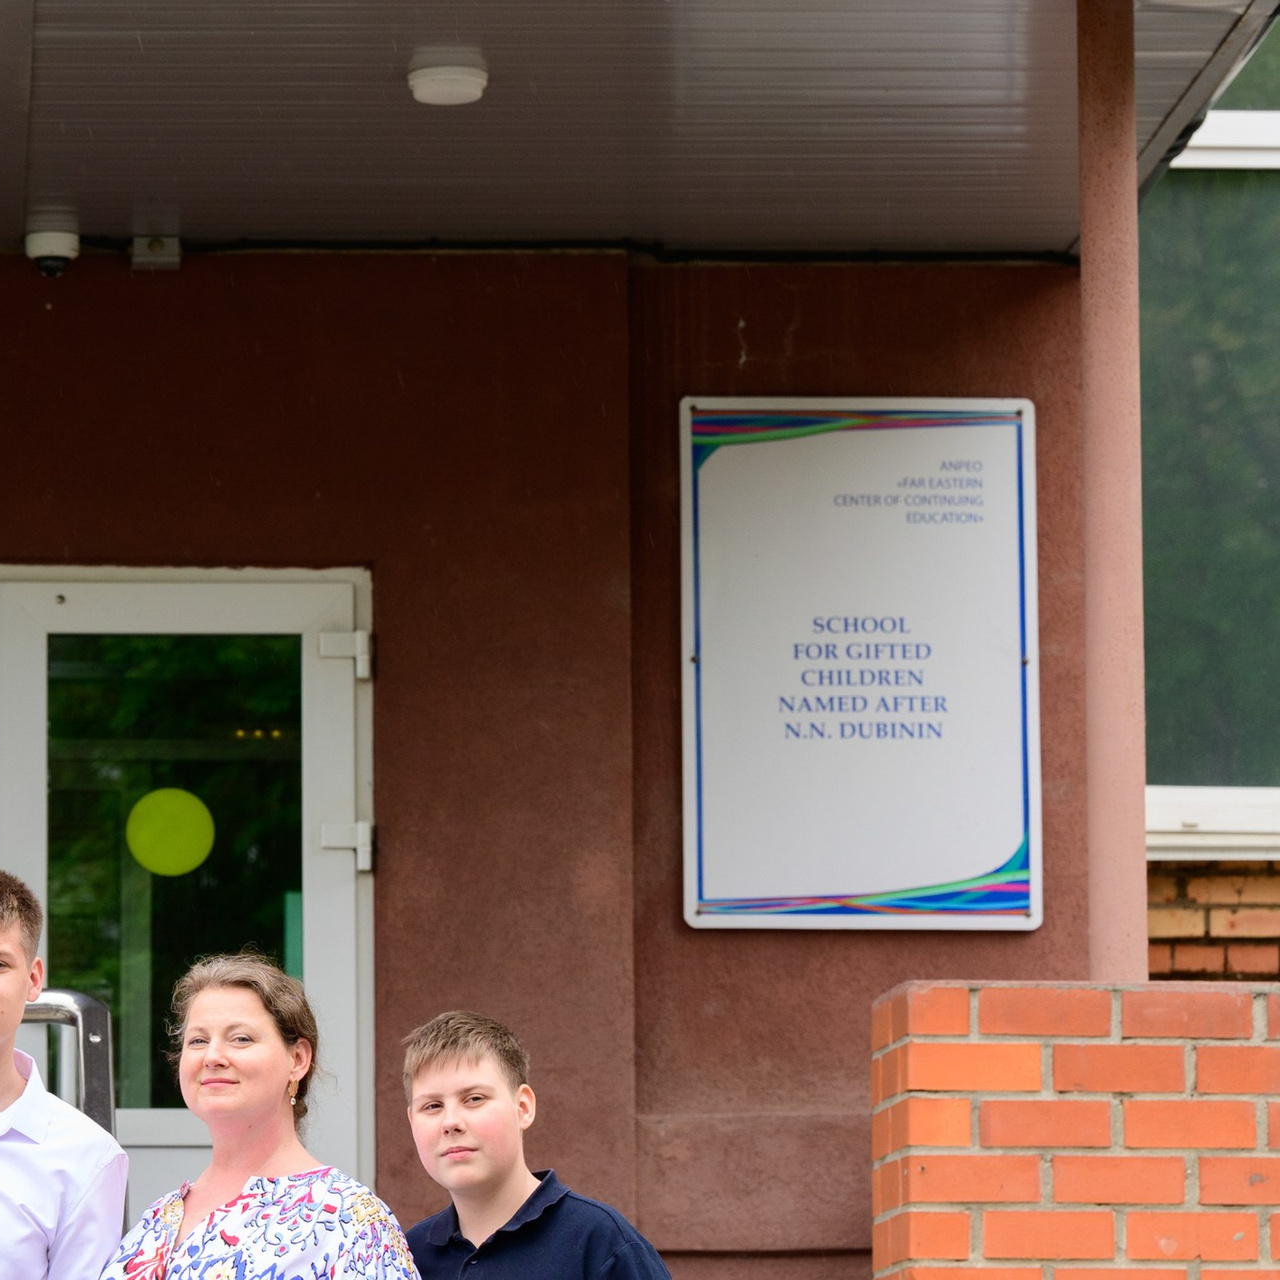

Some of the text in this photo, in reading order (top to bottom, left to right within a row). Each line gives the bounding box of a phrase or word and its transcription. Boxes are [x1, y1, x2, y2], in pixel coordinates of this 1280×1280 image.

[939, 460, 984, 472] ANPEO
[928, 477, 984, 489] EASTERN
[833, 494, 984, 507] CENTER OF CONTINUING
[812, 616, 912, 635] SCHOOL
[792, 642, 933, 661] FOR GIFTED
[800, 668, 924, 687] CHILDREN
[778, 695, 949, 714] NAMED AFTER
[784, 721, 944, 740] N.N. DUBININ
